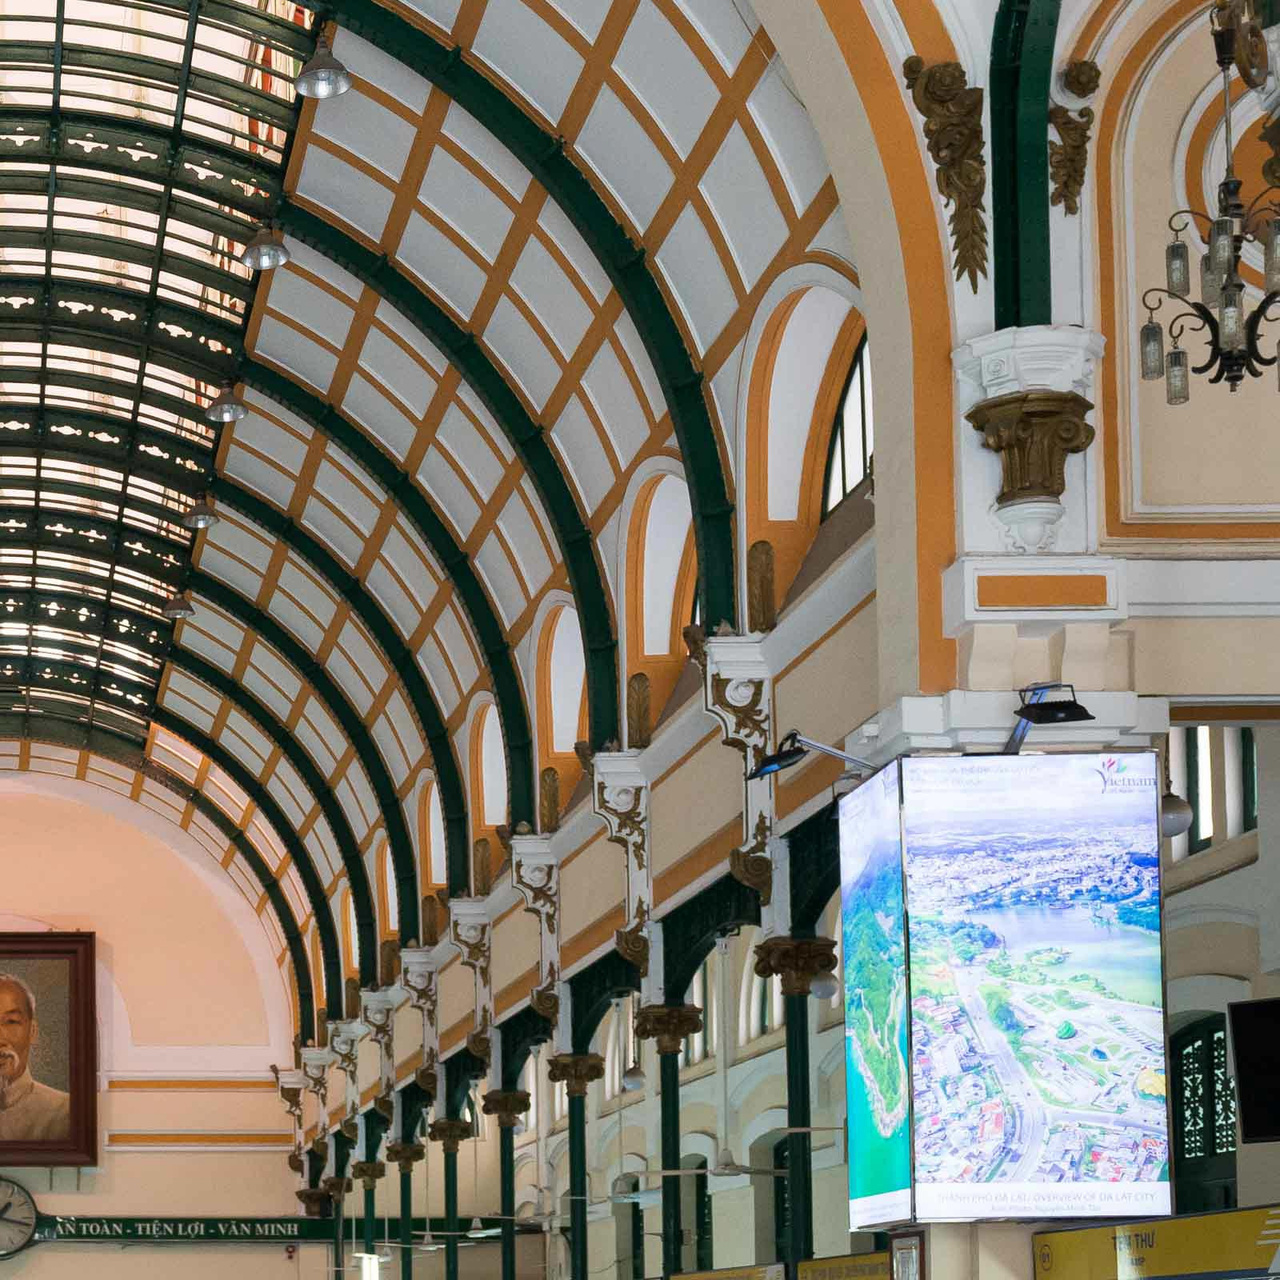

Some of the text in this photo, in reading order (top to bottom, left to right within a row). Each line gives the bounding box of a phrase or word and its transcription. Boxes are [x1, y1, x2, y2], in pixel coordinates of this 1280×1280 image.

[79, 1220, 123, 1235] TOÀN
[135, 1220, 174, 1238] TIỆN
[177, 1221, 205, 1238] LỢI
[218, 1221, 251, 1236] VĂN
[255, 1223, 299, 1235] MINH
